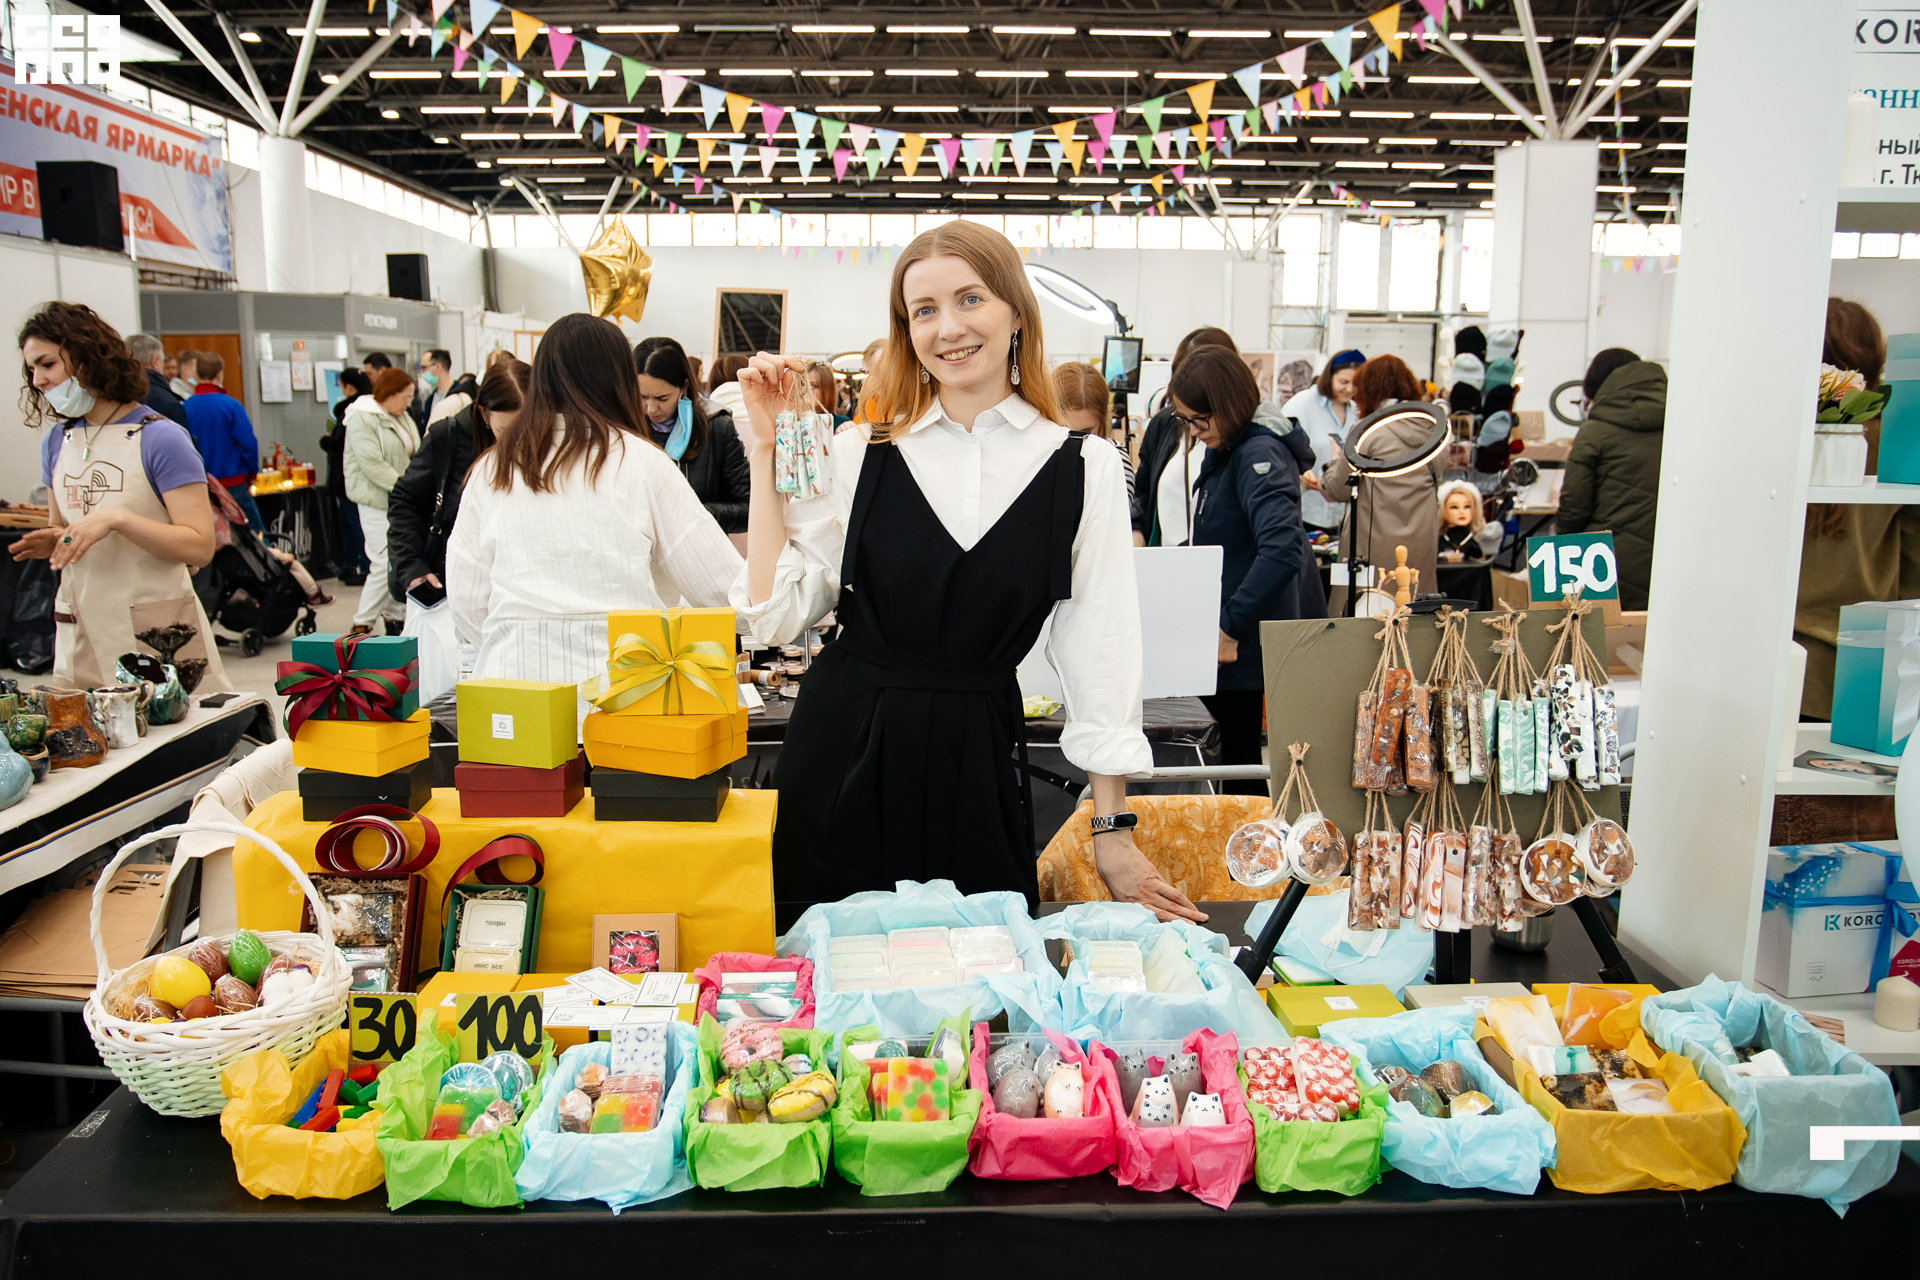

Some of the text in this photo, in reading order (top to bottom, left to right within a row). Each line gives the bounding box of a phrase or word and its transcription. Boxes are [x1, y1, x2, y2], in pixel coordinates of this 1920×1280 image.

[22, 178, 35, 209] В
[1880, 169, 1894, 185] г.
[1528, 542, 1618, 594] 150
[351, 994, 542, 1062] 30 100
